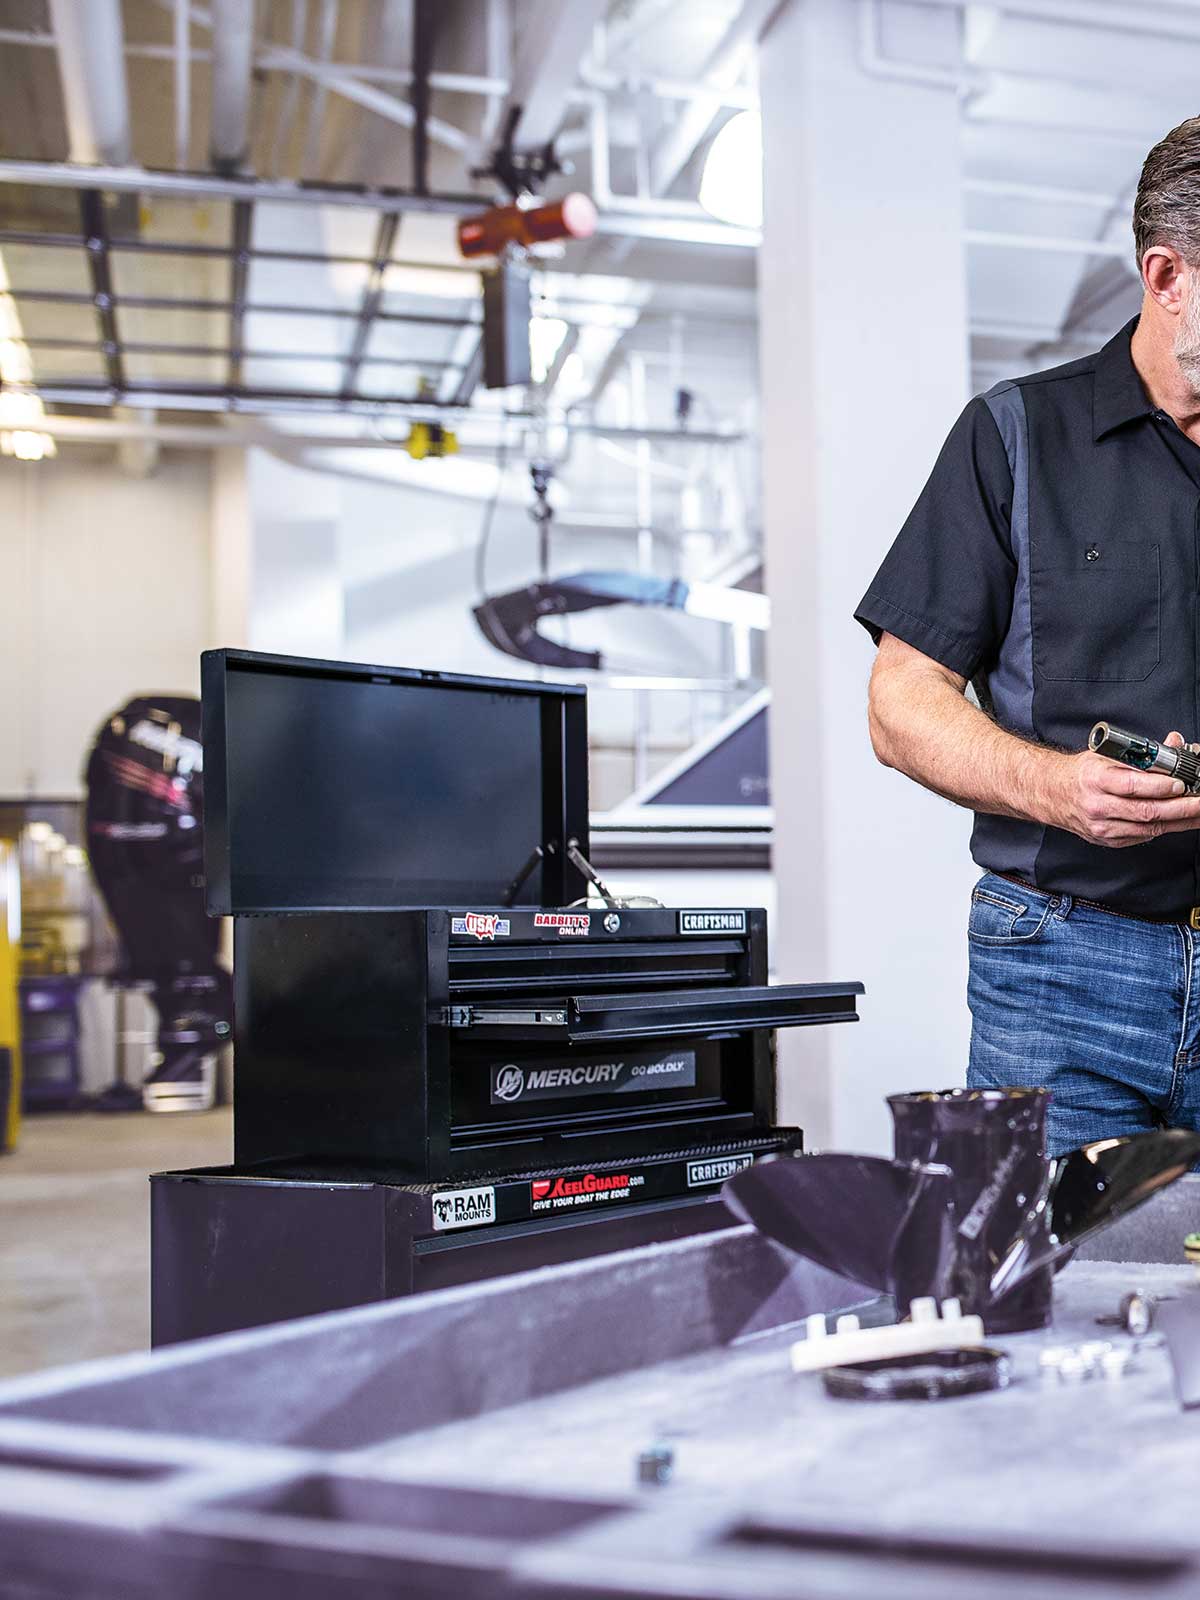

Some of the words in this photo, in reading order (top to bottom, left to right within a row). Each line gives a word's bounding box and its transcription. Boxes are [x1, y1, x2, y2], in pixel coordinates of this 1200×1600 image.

[468, 915, 495, 934] USA
[536, 914, 589, 926] BABBITT'S
[683, 914, 743, 930] CRAFTSMAN
[558, 927, 590, 936] ONLINE
[527, 1063, 624, 1089] MERCURY
[454, 1193, 491, 1212] RAM
[533, 1200, 552, 1210] GIVE
[553, 1196, 573, 1208] YOUR
[574, 1194, 595, 1205] BOAT
[595, 1191, 609, 1200] THE
[610, 1188, 630, 1199] EDGE
[455, 1209, 492, 1222] MOUNTS
